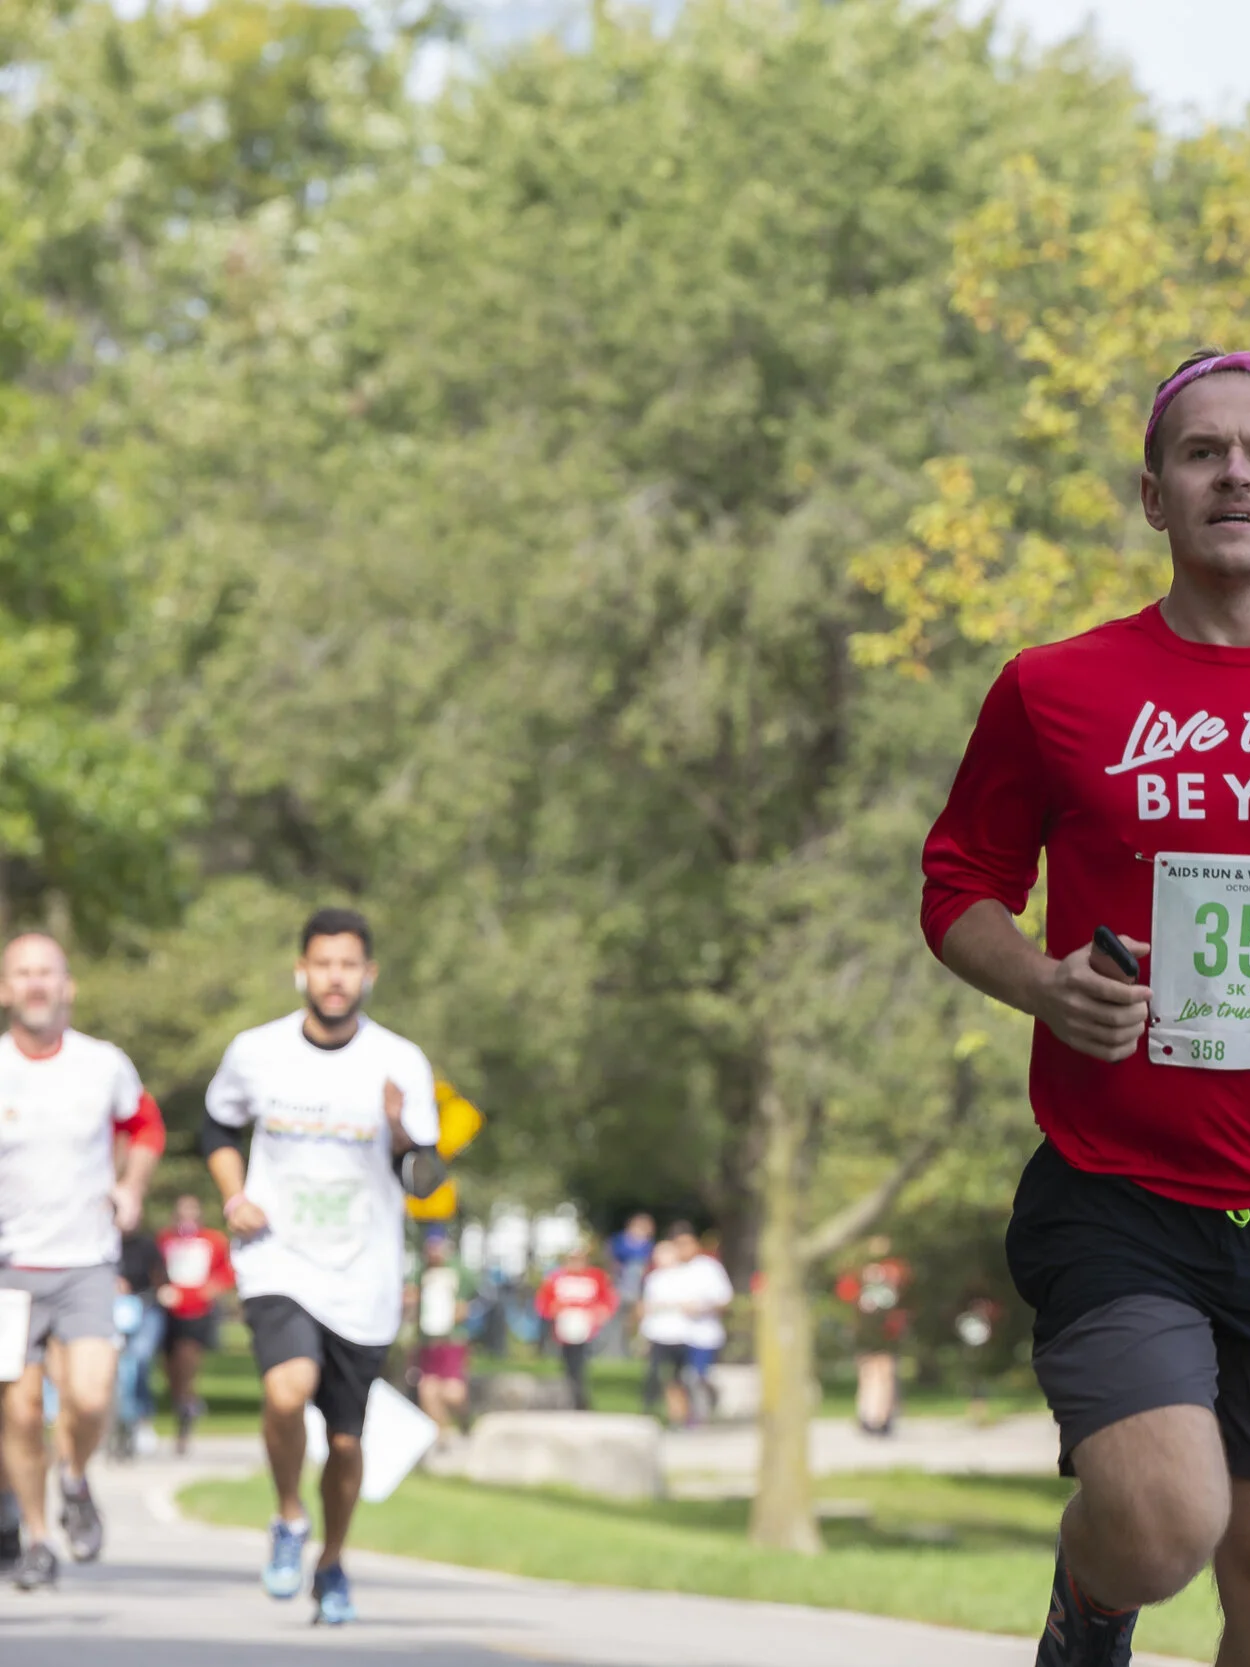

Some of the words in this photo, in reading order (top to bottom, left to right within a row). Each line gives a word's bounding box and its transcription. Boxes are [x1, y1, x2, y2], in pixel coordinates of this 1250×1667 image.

[1104, 701, 1229, 775] Live
[1137, 773, 1206, 820] BE
[1168, 866, 1199, 878] AIDS
[1203, 868, 1231, 879] RUN
[1235, 869, 1244, 880] &
[1226, 984, 1246, 996] 5K
[1174, 998, 1213, 1022] Live
[1191, 1039, 1225, 1061] 358
